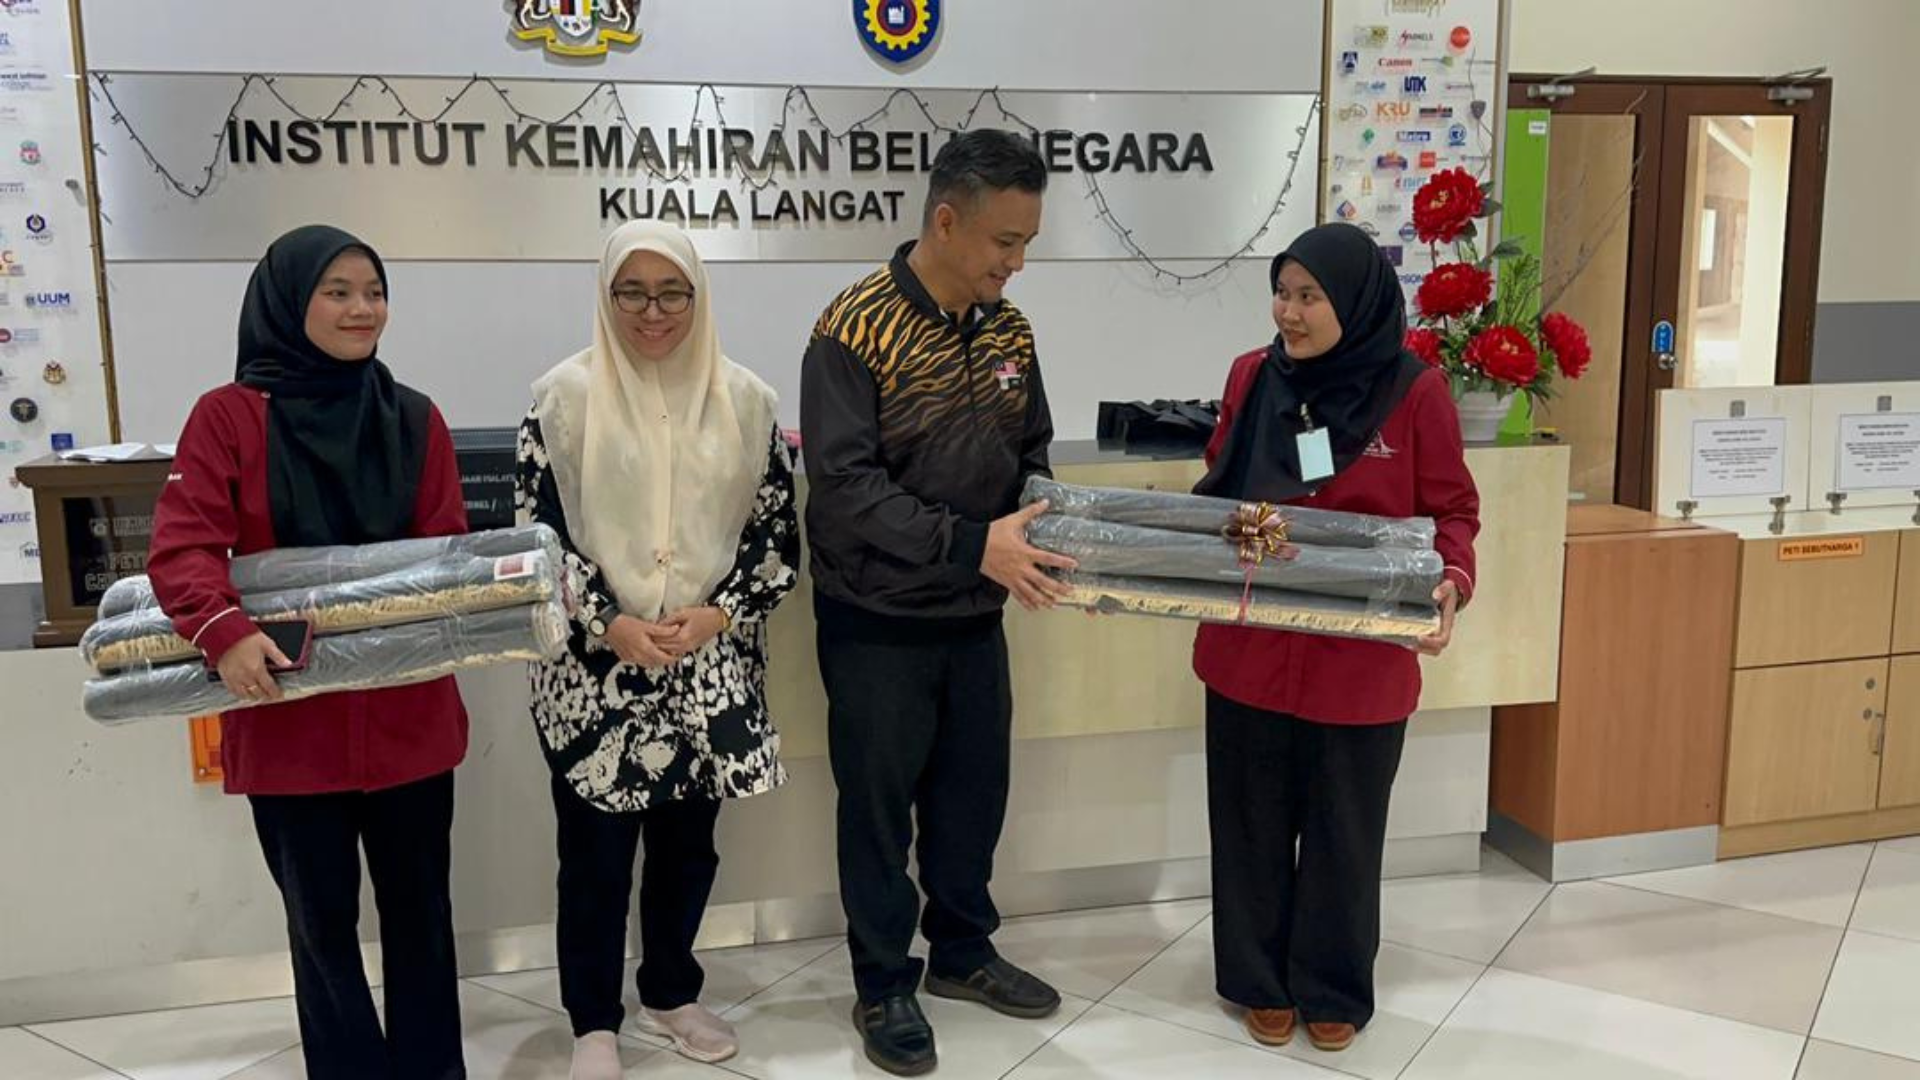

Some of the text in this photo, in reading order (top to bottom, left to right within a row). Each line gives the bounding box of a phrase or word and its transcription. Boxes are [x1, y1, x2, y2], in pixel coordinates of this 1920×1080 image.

[1378, 58, 1412, 68] Canon
[1377, 101, 1412, 118] KRU
[227, 120, 486, 167] INSTITUT
[506, 123, 830, 173] KEMAHIRAN
[600, 187, 905, 222] KUALA LANGAT
[37, 292, 71, 304] UUM
[1782, 546, 1800, 556] PETI
[1802, 543, 1854, 555] SEBUTHARGA
